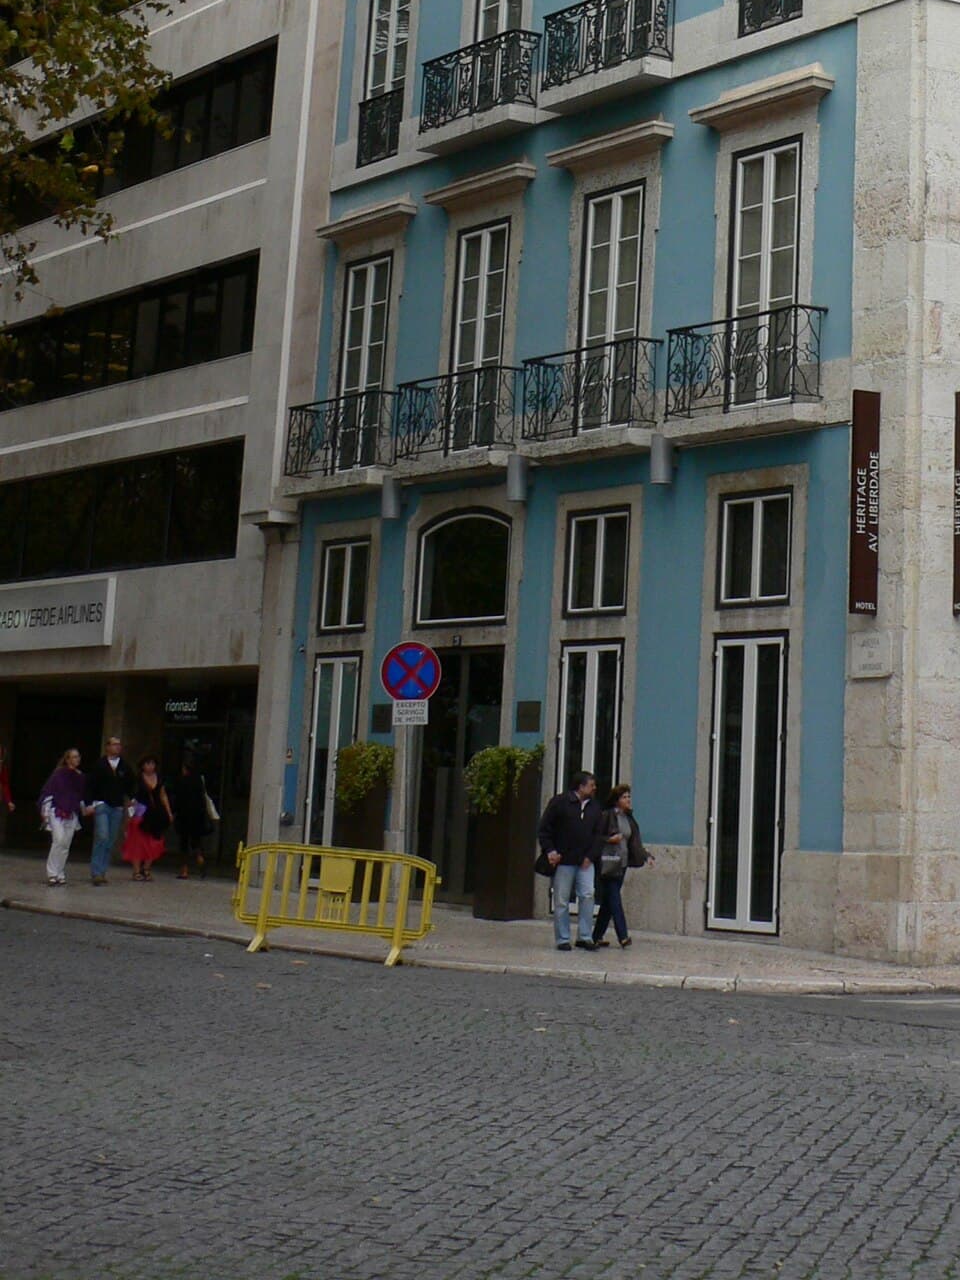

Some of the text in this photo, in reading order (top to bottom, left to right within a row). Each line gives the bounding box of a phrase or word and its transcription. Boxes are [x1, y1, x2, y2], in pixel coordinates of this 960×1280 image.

[856, 467, 867, 534] HERITAGE
[868, 451, 880, 552] AV LIBERDADE
[23, 606, 57, 628] VERDE
[57, 602, 104, 625] AIRLINES
[855, 601, 876, 610] HOTEL
